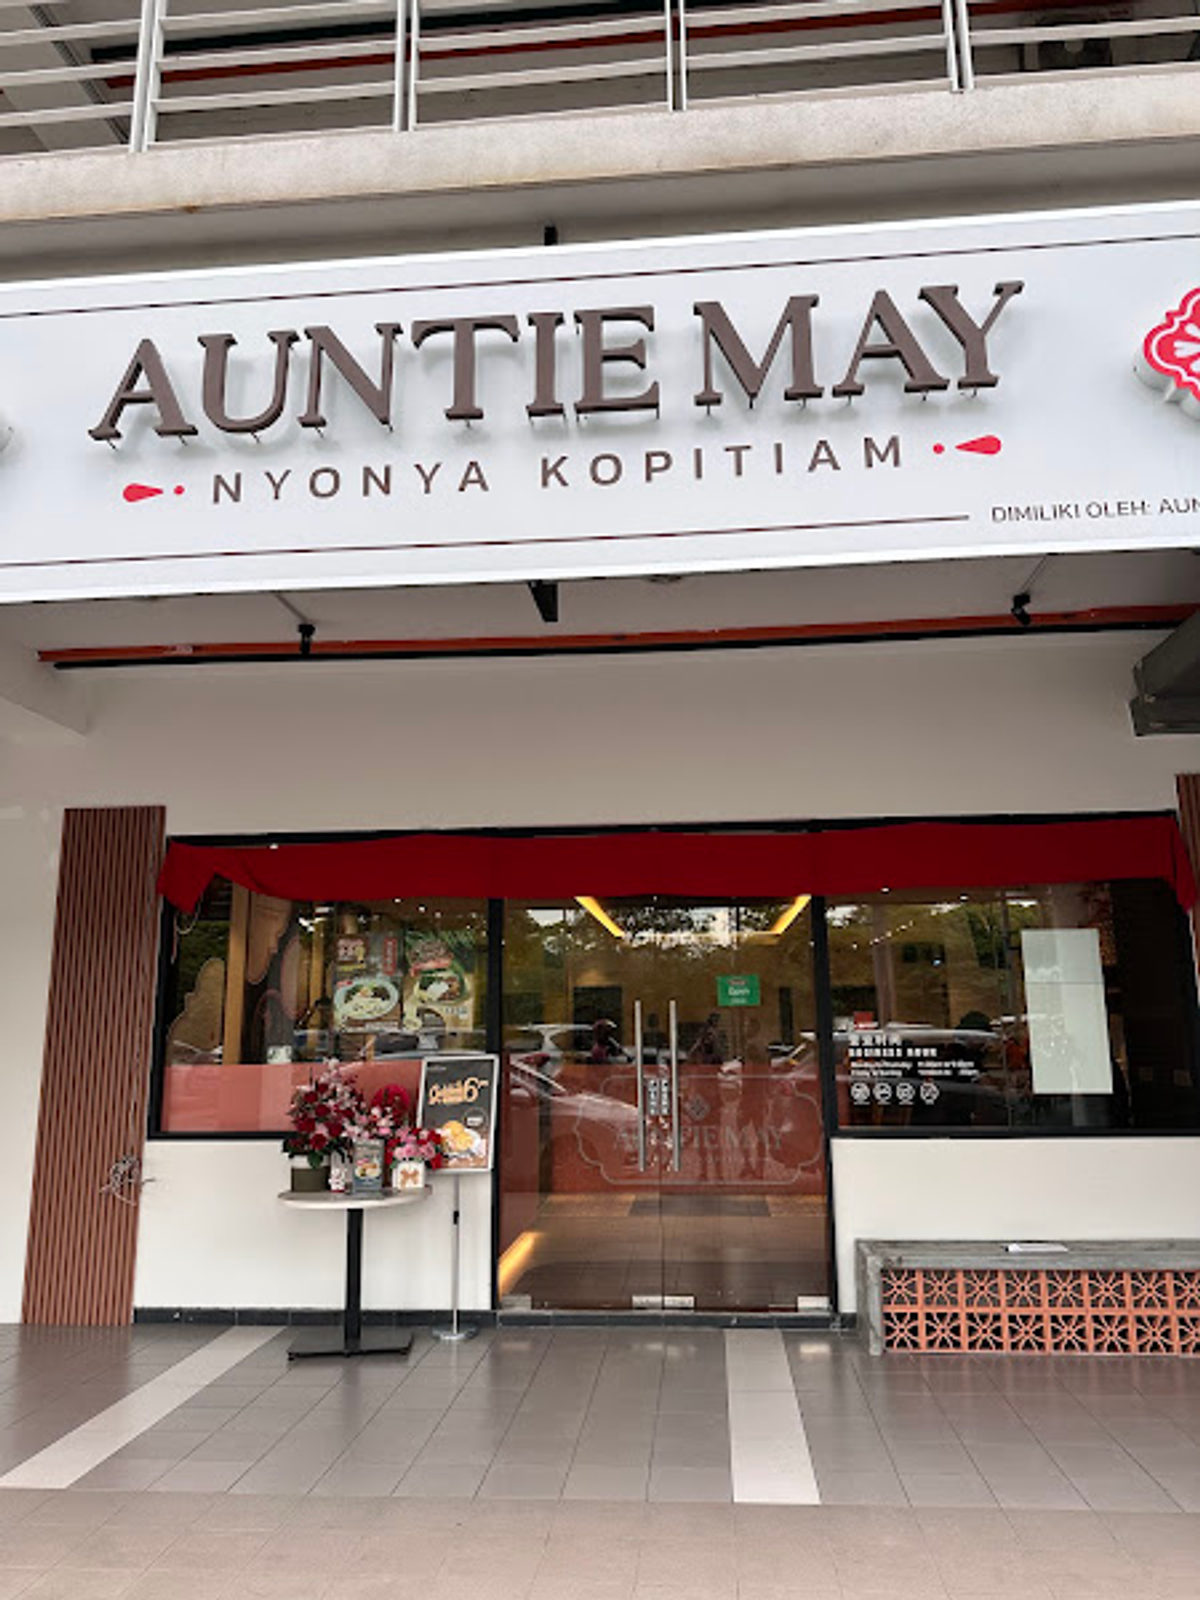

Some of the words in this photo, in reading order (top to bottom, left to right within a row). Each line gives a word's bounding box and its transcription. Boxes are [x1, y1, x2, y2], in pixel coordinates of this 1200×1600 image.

[88, 304, 661, 442] AUNTIE
[693, 280, 1024, 408] MAY
[212, 459, 490, 504] NYONYA
[540, 434, 903, 487] KOPITIAM
[991, 503, 1081, 522] DIMILIKI
